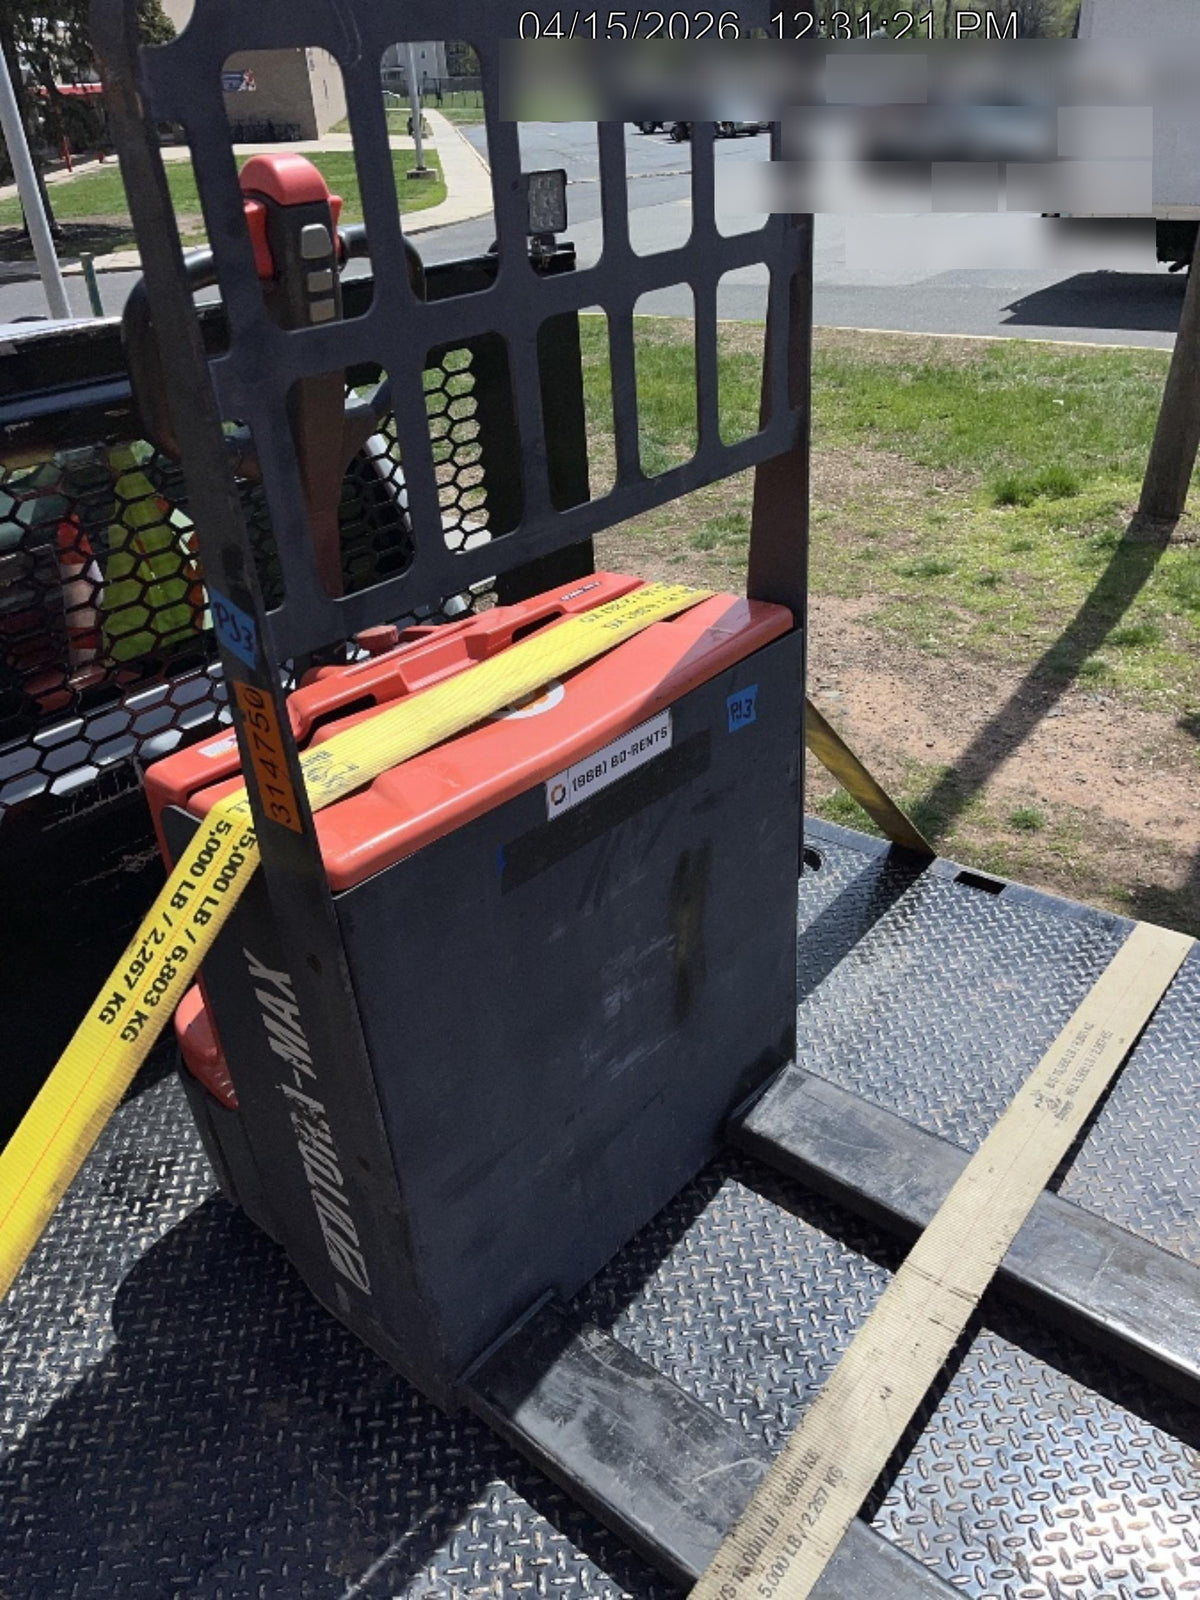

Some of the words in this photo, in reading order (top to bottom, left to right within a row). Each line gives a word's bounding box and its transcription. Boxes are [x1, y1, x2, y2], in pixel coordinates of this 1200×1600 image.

[244, 687, 292, 824] 314750
[189, 820, 232, 877] 5,000
[170, 880, 196, 910] LB
[193, 896, 219, 926] LB
[163, 912, 173, 927] /
[185, 929, 196, 944] /
[124, 928, 165, 990] 2,267
[144, 945, 188, 1006] 6,803
[98, 992, 126, 1024] KG
[120, 1010, 149, 1042] KG
